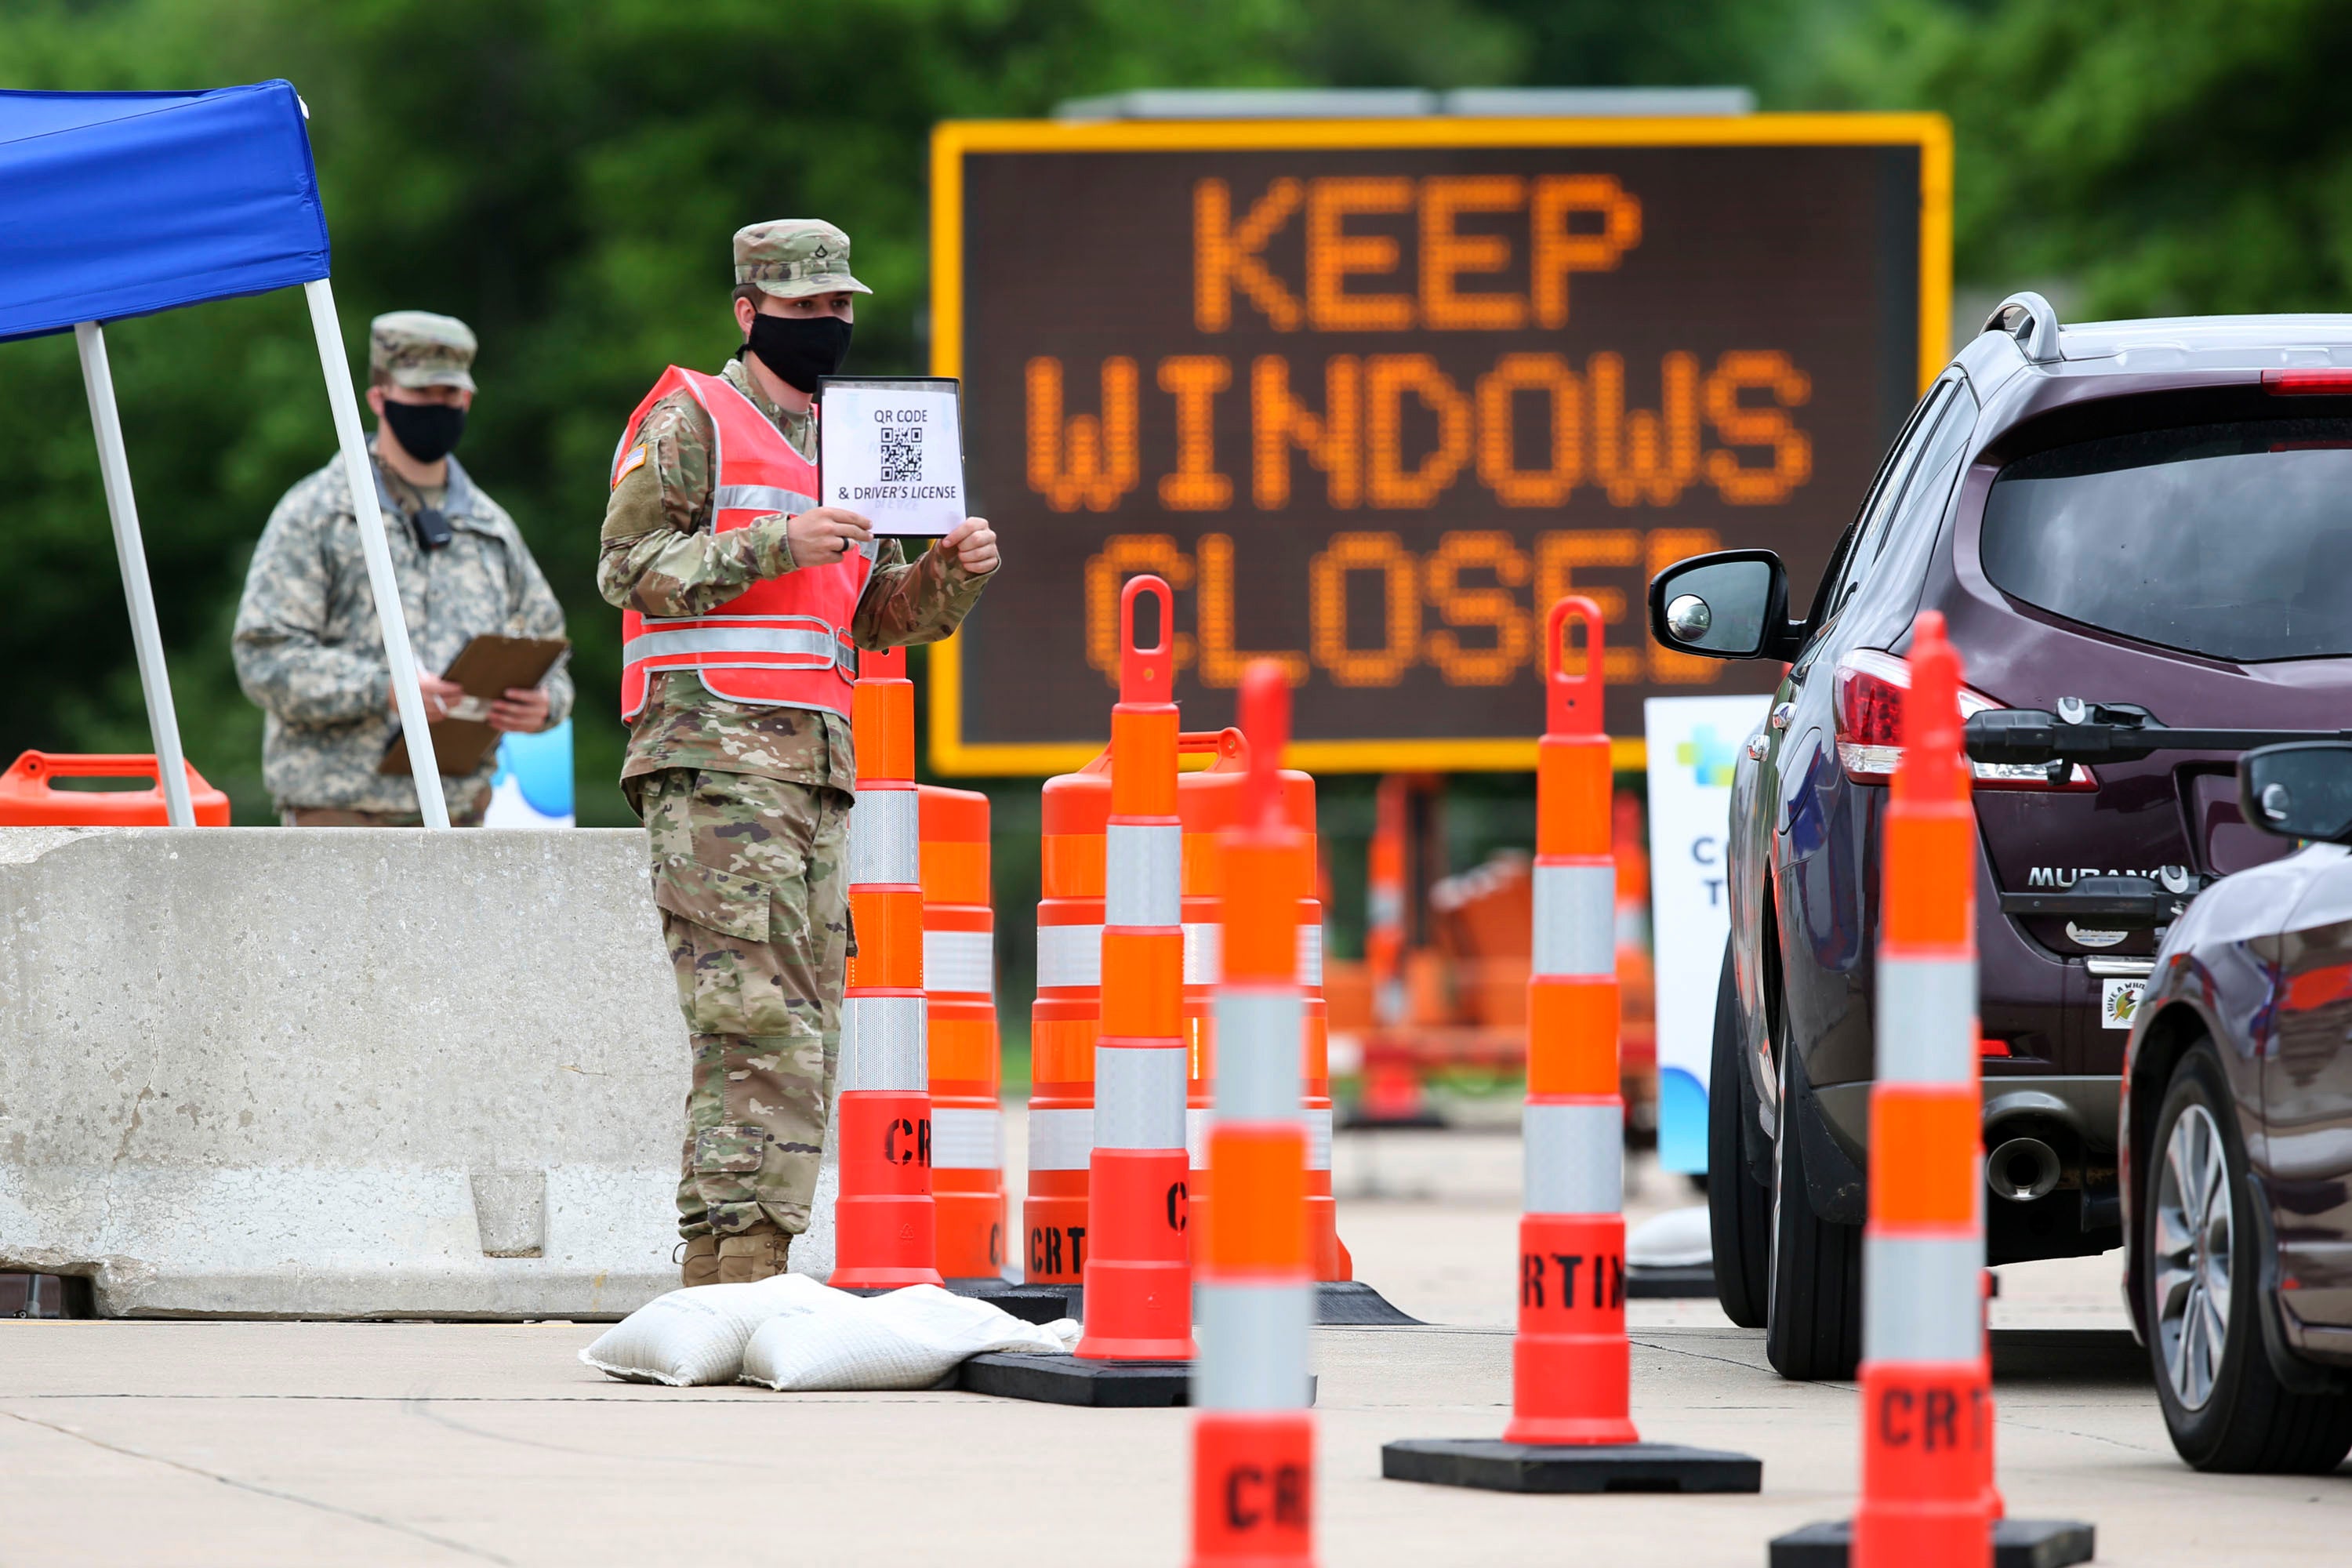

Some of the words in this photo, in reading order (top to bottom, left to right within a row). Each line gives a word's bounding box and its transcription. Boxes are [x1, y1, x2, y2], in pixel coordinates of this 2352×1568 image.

[1192, 175, 1642, 333] KEEP
[874, 410, 893, 423] QR
[897, 410, 927, 423] CODE
[1025, 350, 1813, 513] WINDOWS
[838, 487, 849, 499] &
[855, 486, 908, 499] DRIVER'S
[911, 486, 956, 499] LICENSE
[1031, 1227, 1086, 1275] CRT
